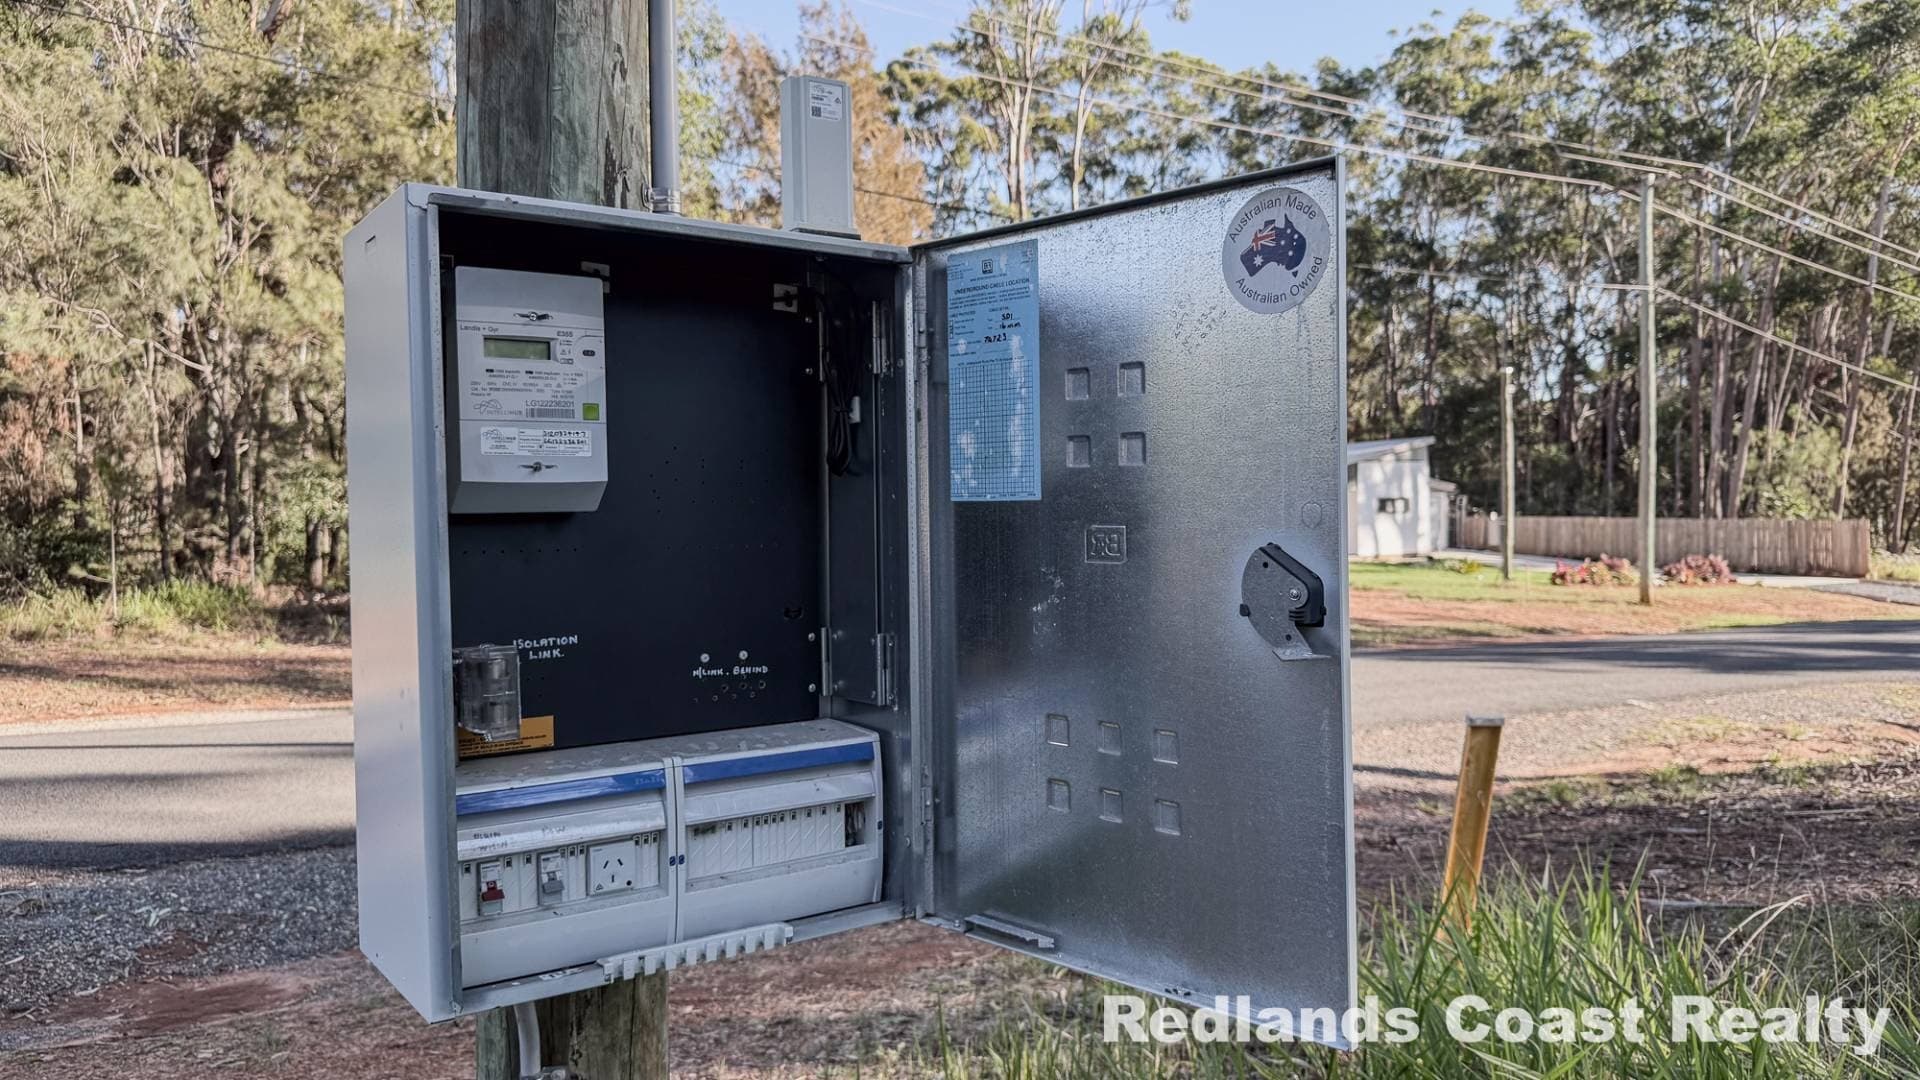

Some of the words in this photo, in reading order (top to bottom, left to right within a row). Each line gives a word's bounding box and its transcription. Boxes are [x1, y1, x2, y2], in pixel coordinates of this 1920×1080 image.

[1229, 198, 1282, 243] Australian
[1285, 195, 1317, 220] Made
[1236, 278, 1287, 304] Australian
[1290, 256, 1323, 296] Owned
[512, 634, 578, 649] ISOLATION
[733, 665, 768, 676] BEHIND
